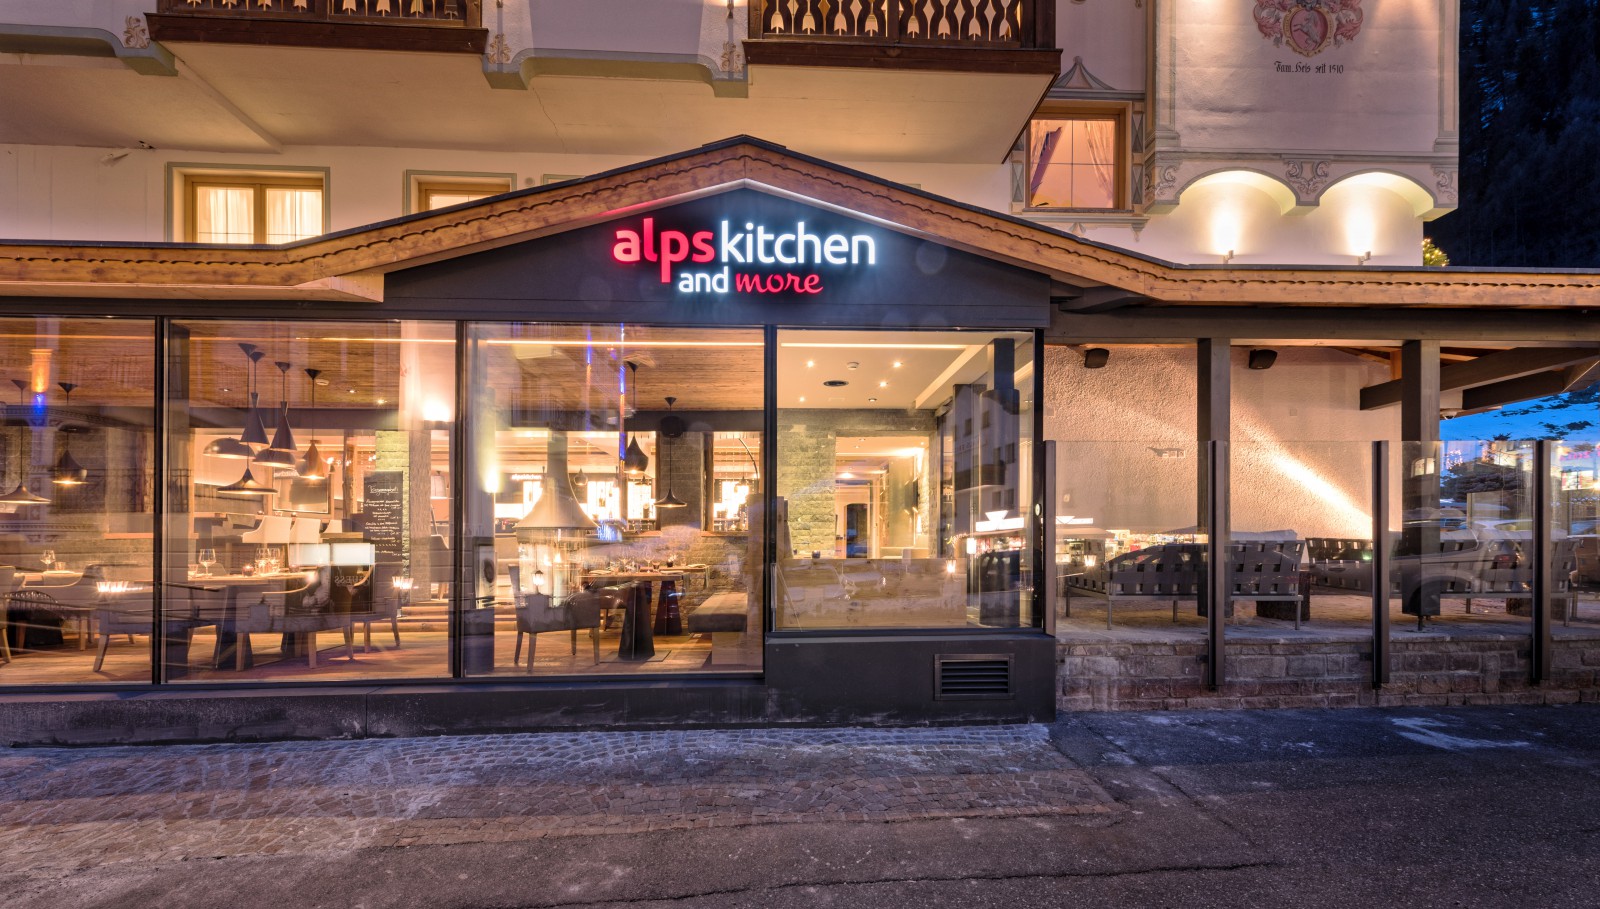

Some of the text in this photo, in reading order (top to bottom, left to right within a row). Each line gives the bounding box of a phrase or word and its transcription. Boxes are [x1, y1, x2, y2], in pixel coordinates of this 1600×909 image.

[1315, 63, 1326, 74] seit
[1329, 64, 1344, 74] 1510
[678, 266, 823, 294] and more
